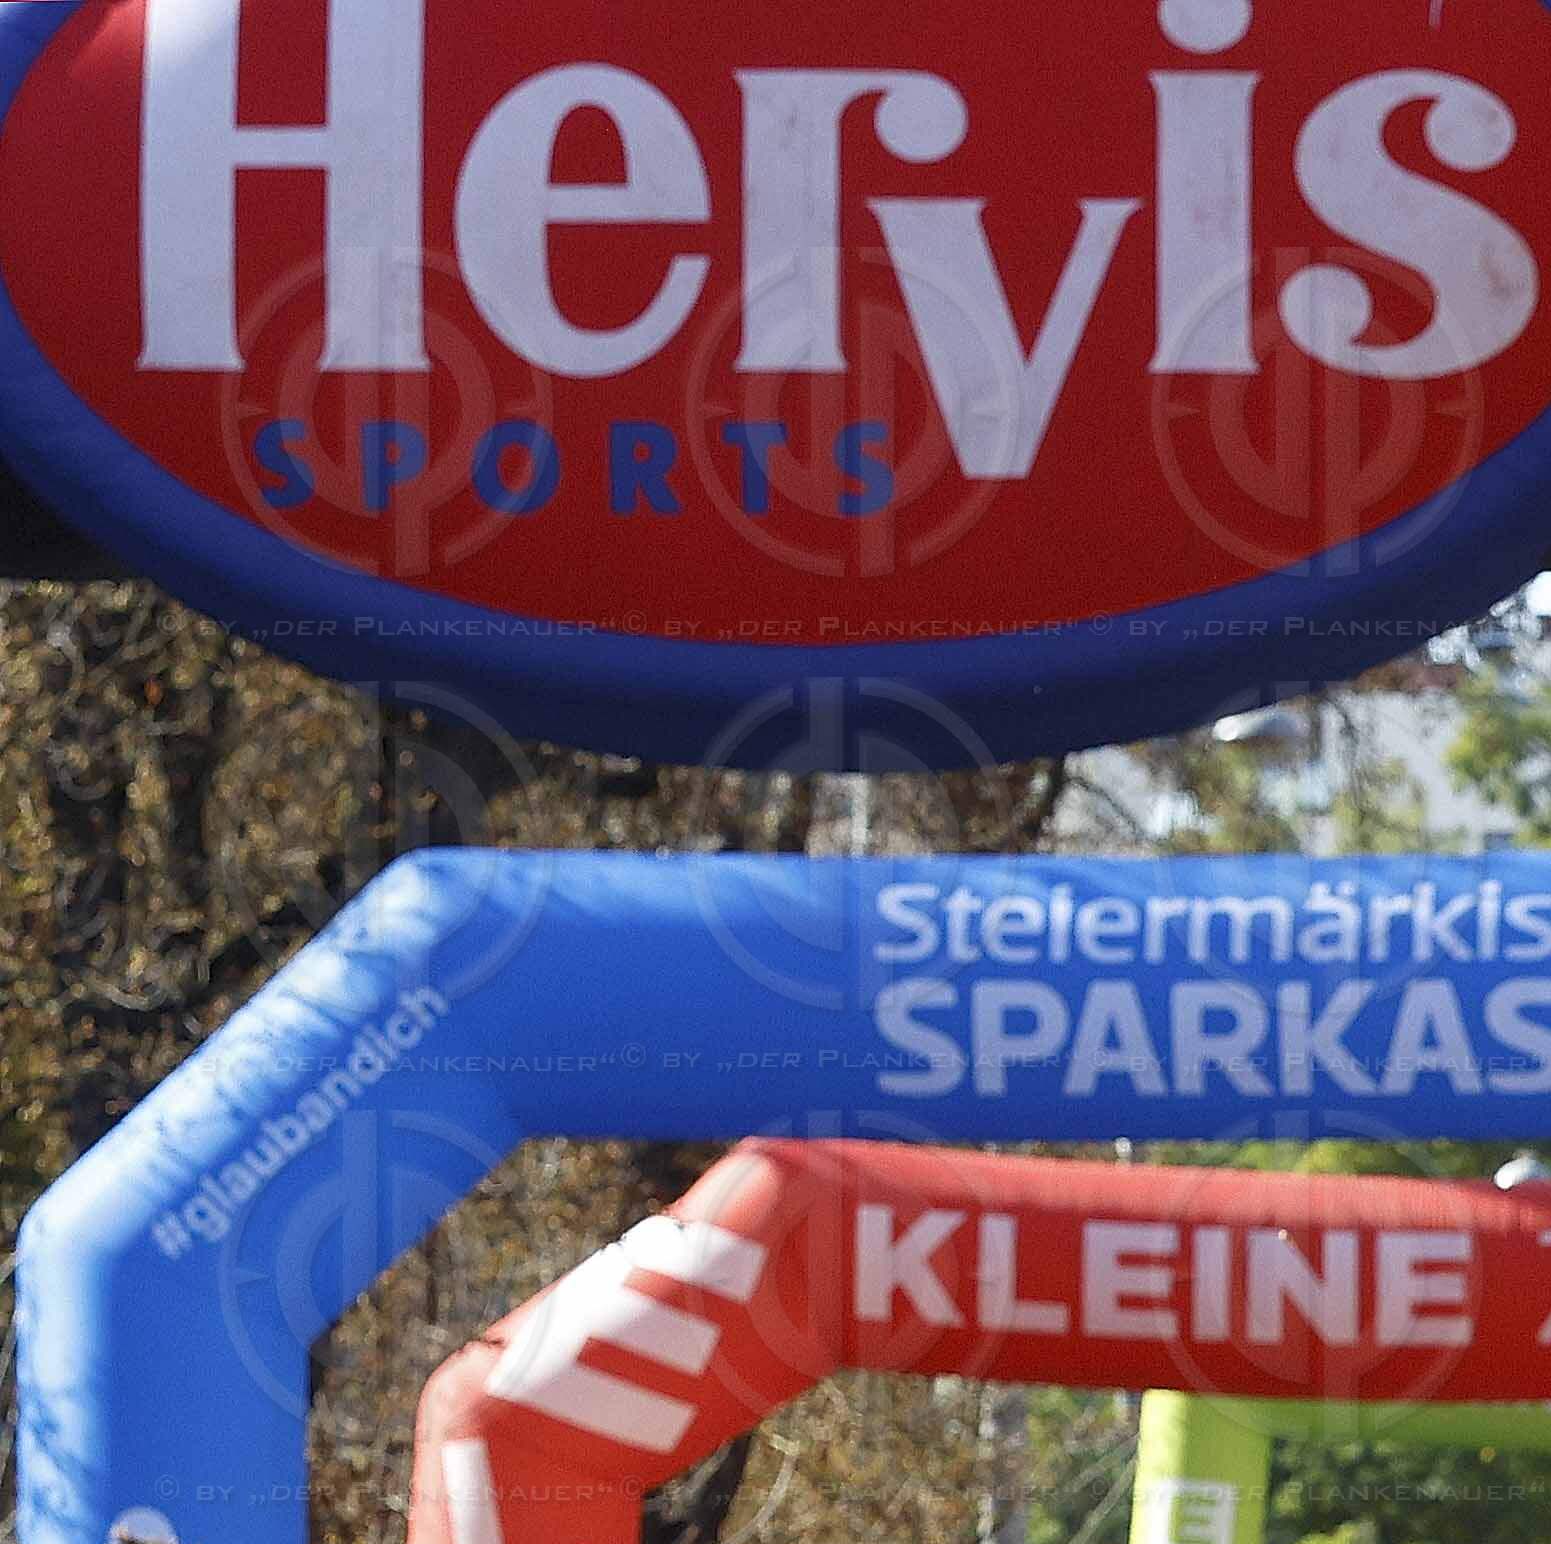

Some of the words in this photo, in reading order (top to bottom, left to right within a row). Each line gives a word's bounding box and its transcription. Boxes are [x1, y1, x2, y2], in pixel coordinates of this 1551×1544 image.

[136, 0, 1540, 481] Hervis
[252, 415, 896, 518] SPORTS
[153, 985, 449, 1260] #glaubandich
[853, 1204, 1475, 1346] KLEINE
